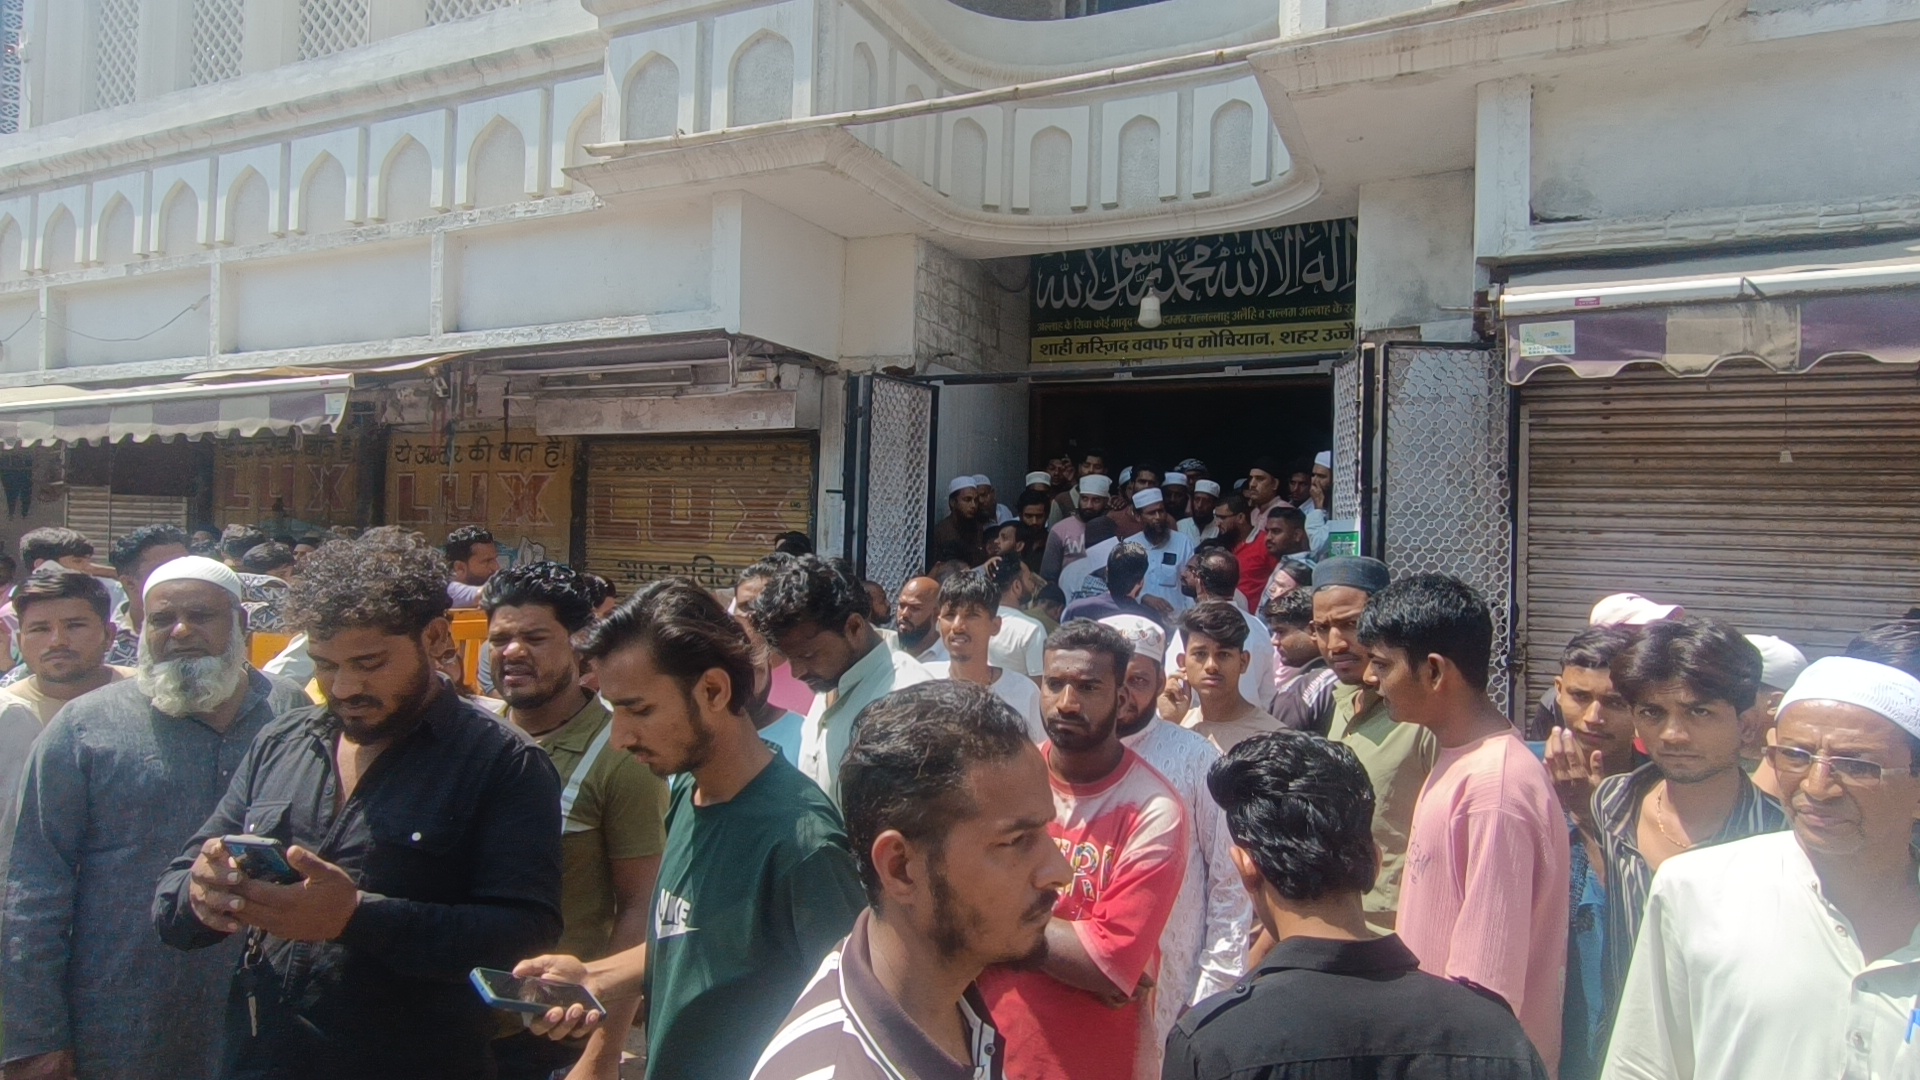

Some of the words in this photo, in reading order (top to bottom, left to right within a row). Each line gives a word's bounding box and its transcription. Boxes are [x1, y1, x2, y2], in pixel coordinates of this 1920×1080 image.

[1039, 337, 1073, 356] शाही
[1172, 332, 1194, 350] पंच
[1279, 328, 1319, 345] शहर
[1322, 322, 1355, 342] उज्जै
[395, 439, 412, 463] ये
[468, 436, 494, 463] की
[498, 441, 539, 463] बात
[223, 463, 348, 512] LUX
[396, 471, 557, 526] LUX
